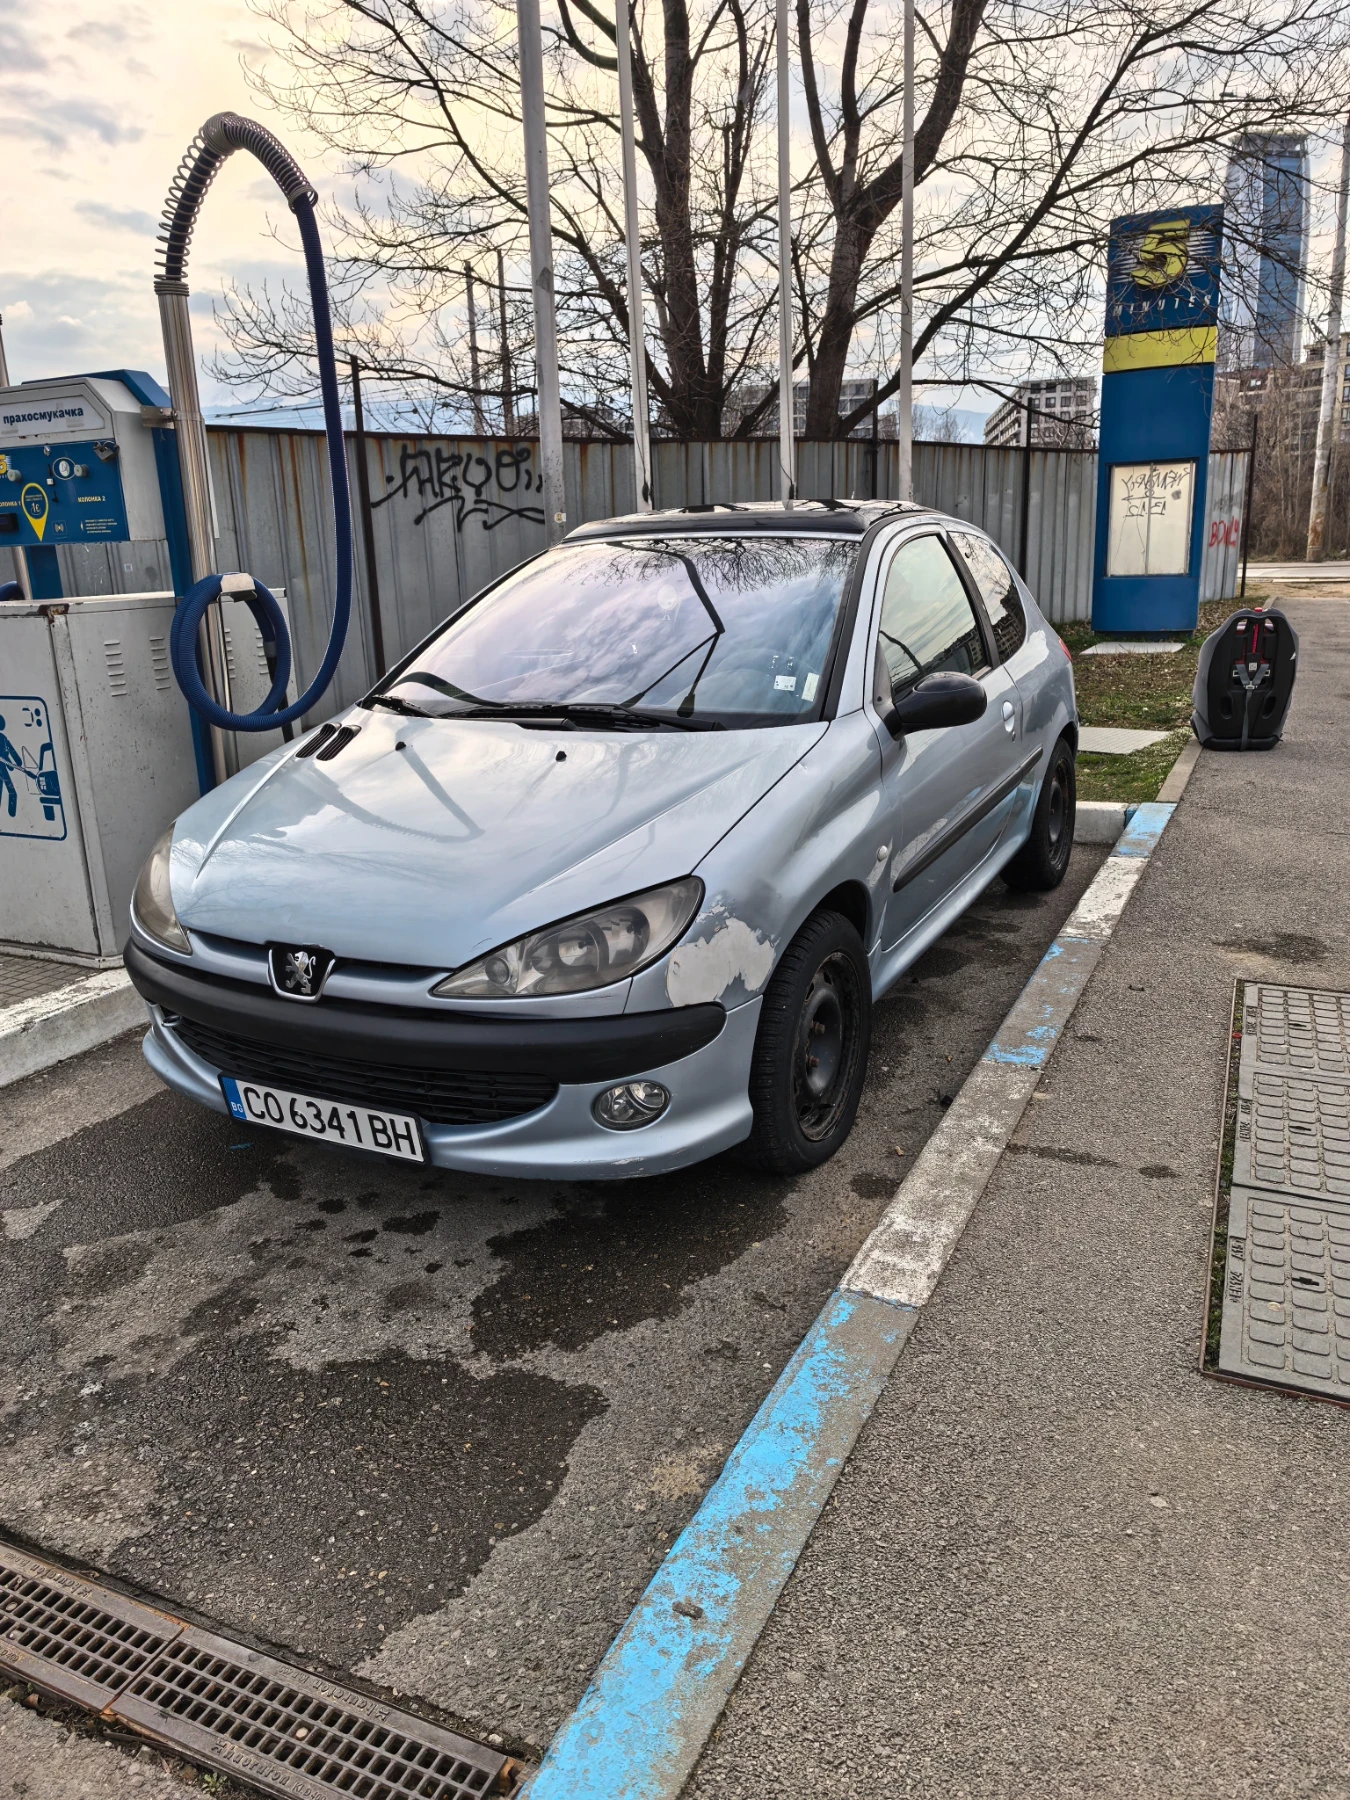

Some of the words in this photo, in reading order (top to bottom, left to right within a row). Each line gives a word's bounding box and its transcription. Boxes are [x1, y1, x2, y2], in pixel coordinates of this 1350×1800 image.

[1131, 219, 1191, 289] 5
[1112, 295, 1212, 316] MINUTES
[3, 407, 84, 426] прахосмукачка
[231, 1102, 244, 1113] BG
[243, 1086, 284, 1124] CO
[289, 1097, 364, 1144] 6341
[367, 1113, 417, 1155] BH
